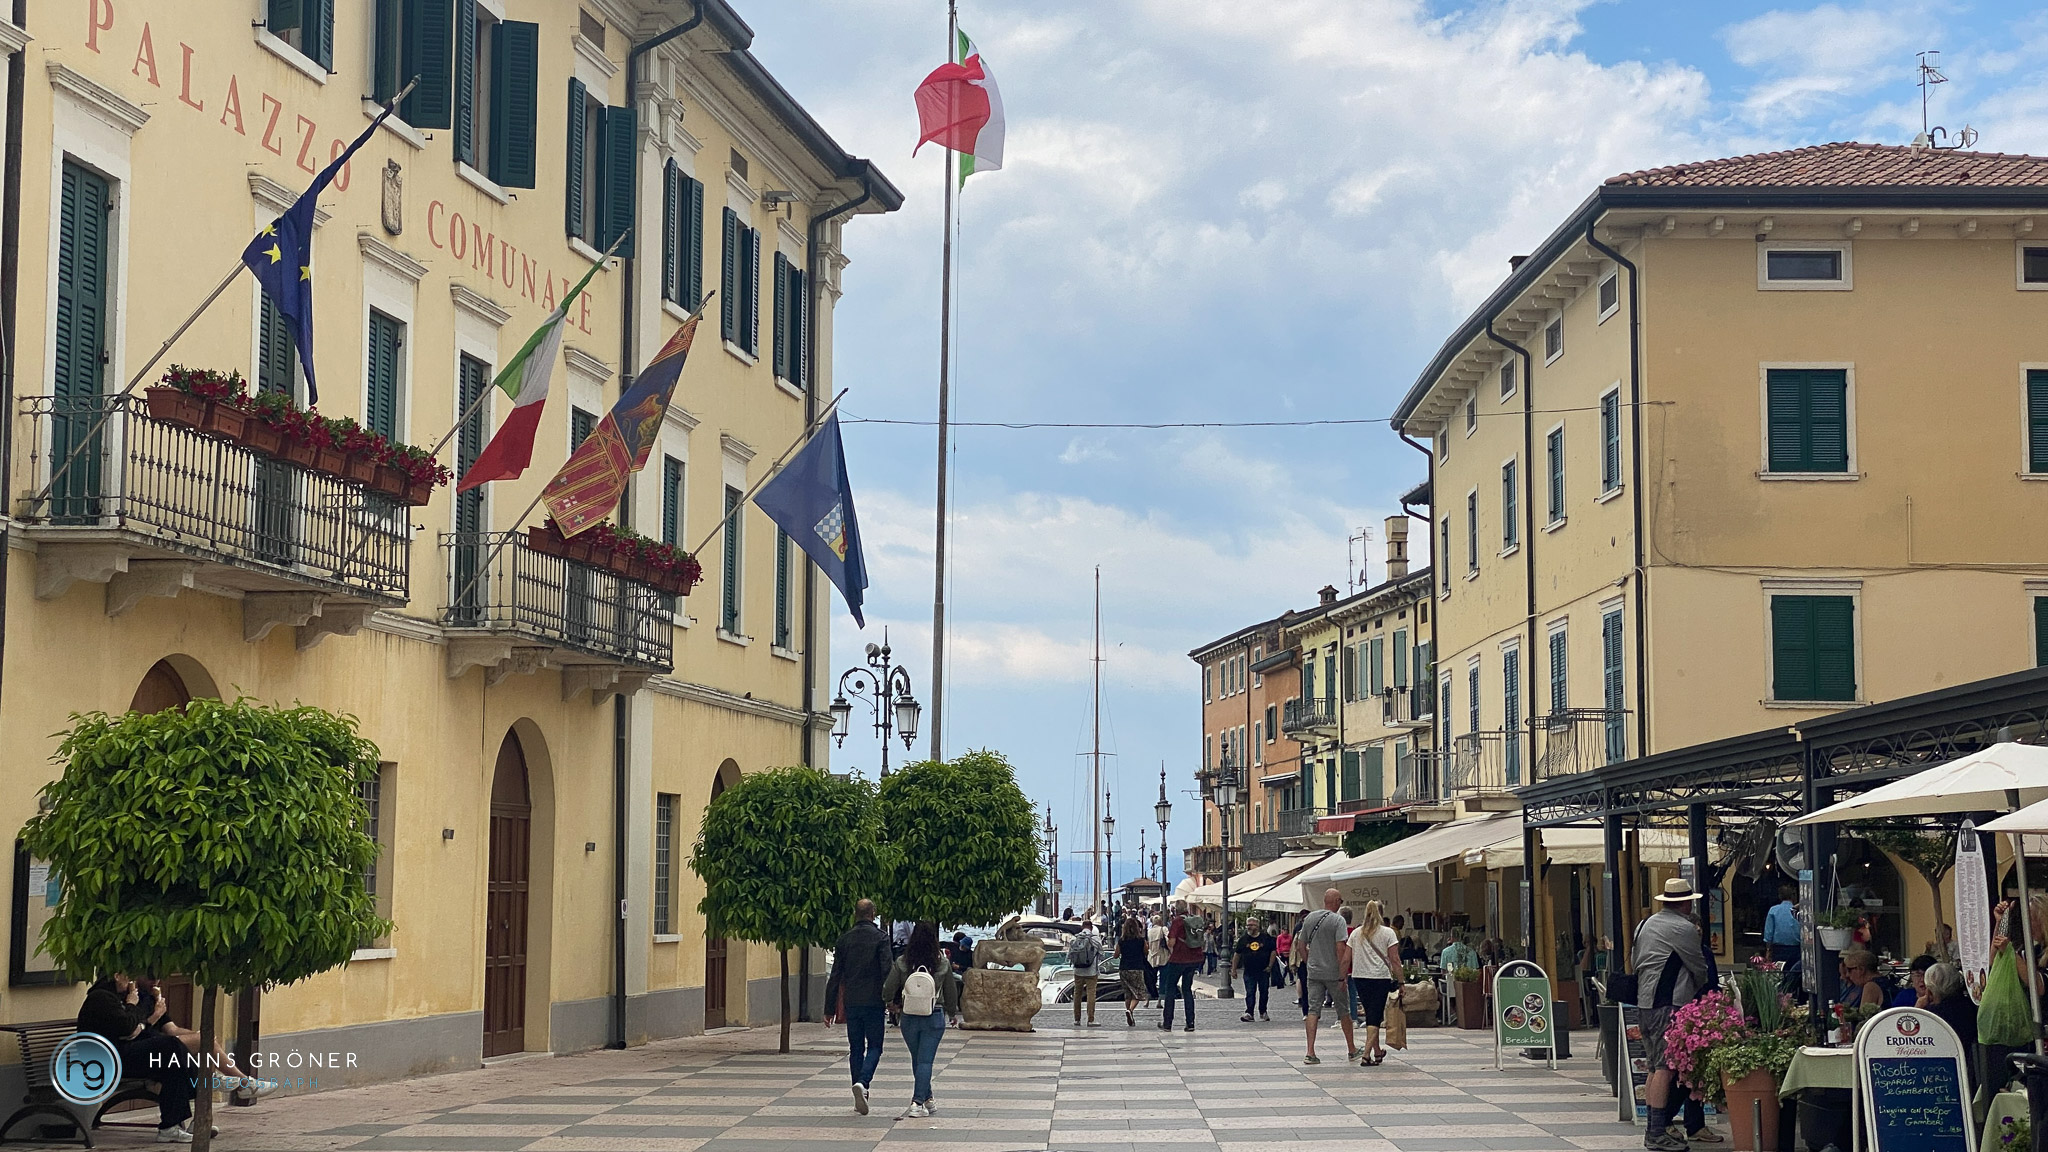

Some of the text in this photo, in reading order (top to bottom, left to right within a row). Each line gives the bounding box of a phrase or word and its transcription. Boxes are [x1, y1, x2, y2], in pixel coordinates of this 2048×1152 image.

[84, 0, 352, 192] PALAZZO
[427, 199, 593, 336] COMUNALE
[1505, 1036, 1547, 1045] Breakfast
[1886, 1036, 1936, 1047] ERDINGER
[1872, 1061, 1917, 1078] Risotto
